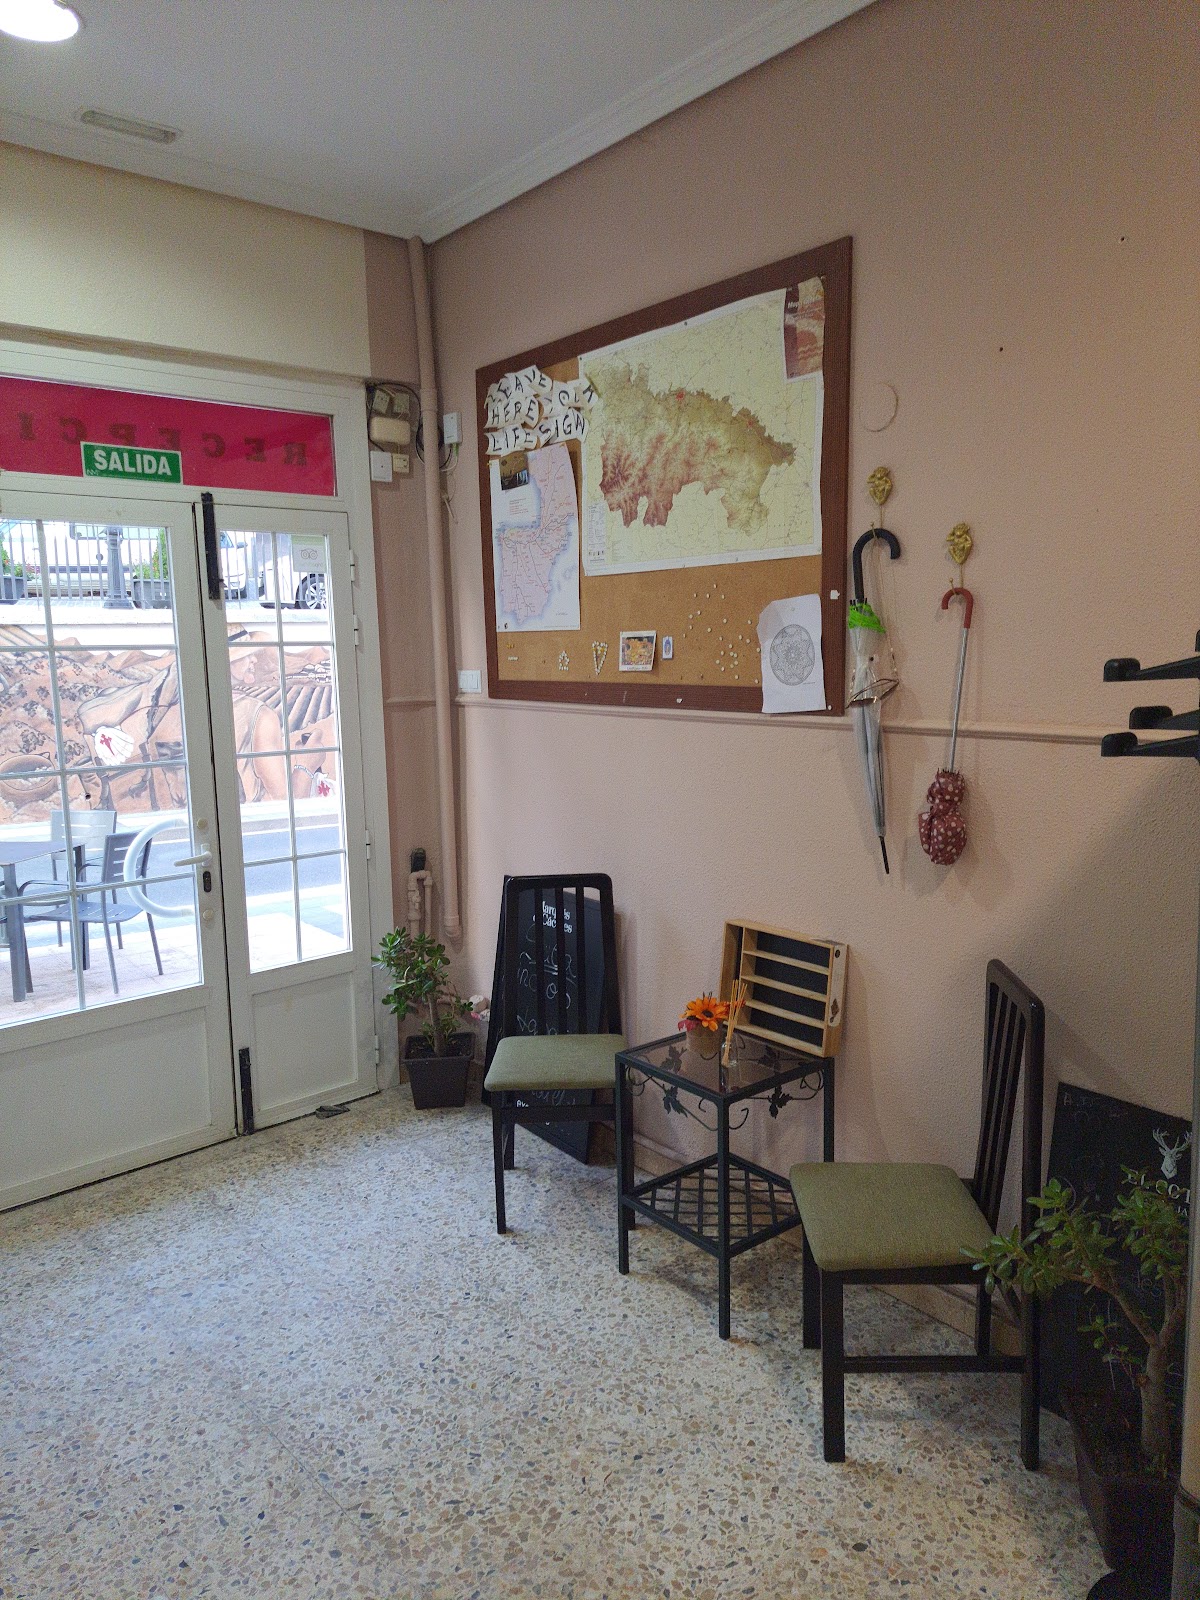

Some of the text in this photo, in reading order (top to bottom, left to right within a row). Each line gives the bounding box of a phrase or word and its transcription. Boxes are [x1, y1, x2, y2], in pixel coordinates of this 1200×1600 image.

[491, 399, 537, 425] HERE
[491, 413, 586, 452] LIFE SIGN
[93, 449, 172, 476] SALIDA
